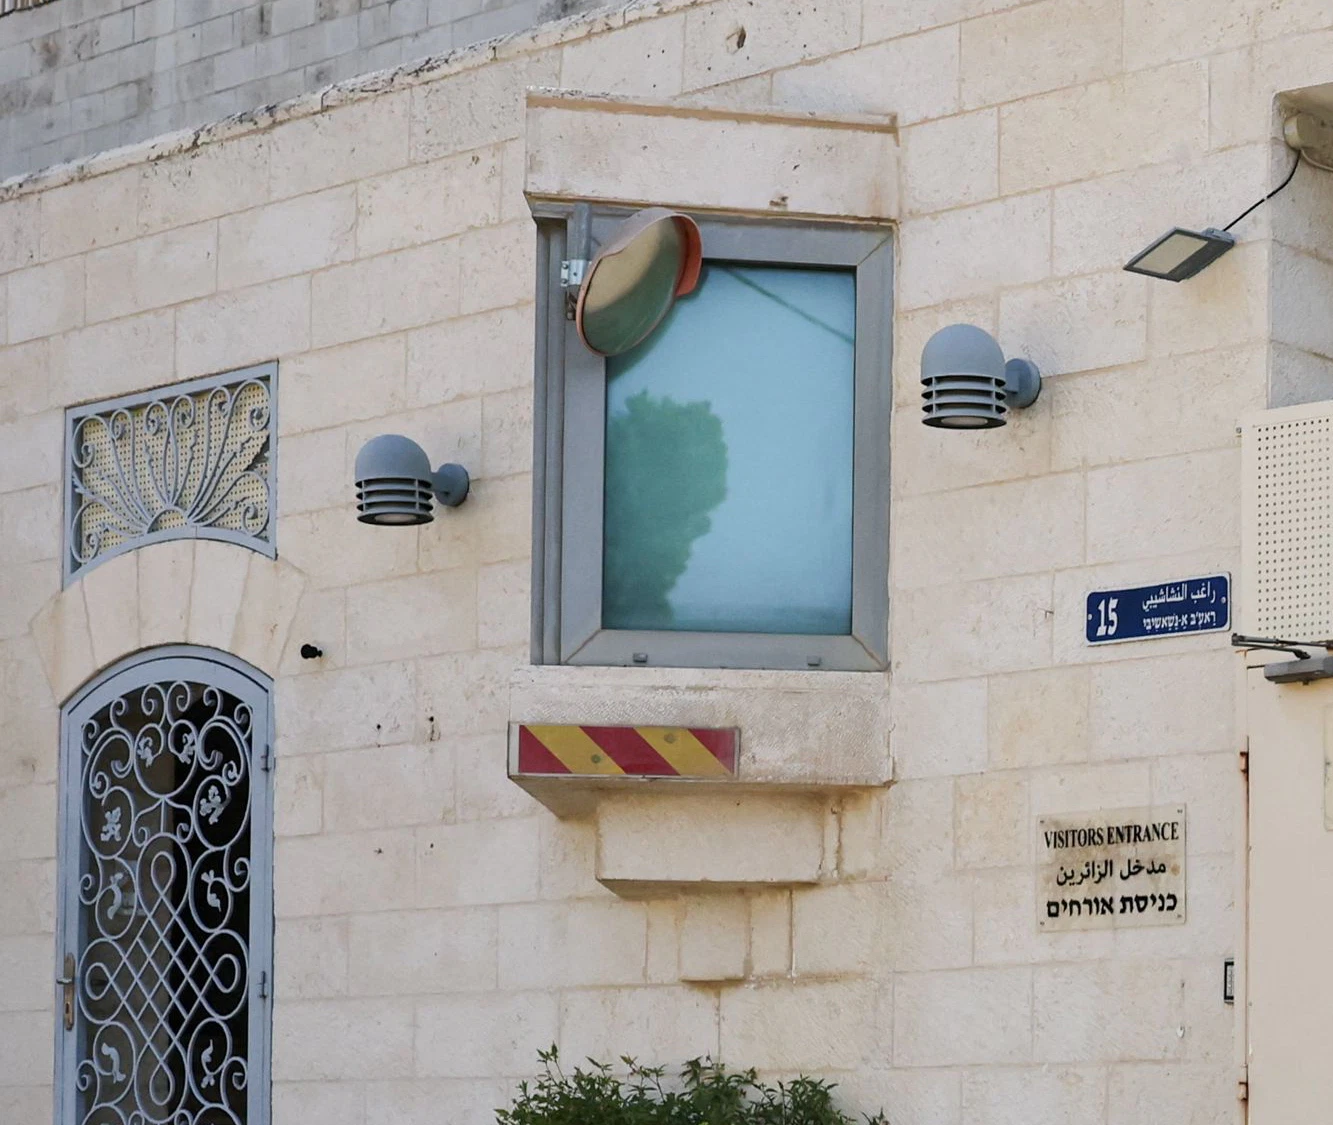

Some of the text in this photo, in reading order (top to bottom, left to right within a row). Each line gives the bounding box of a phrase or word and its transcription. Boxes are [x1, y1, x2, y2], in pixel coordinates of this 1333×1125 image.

[1142, 581, 1216, 613] راغب النشاشيبي
[1096, 597, 1119, 637] 15
[1044, 821, 1180, 849] VISITORS ENTRANCE
[1056, 858, 1167, 886] مدخل الزائرين
[1046, 892, 1178, 918] כניסת אורחים
